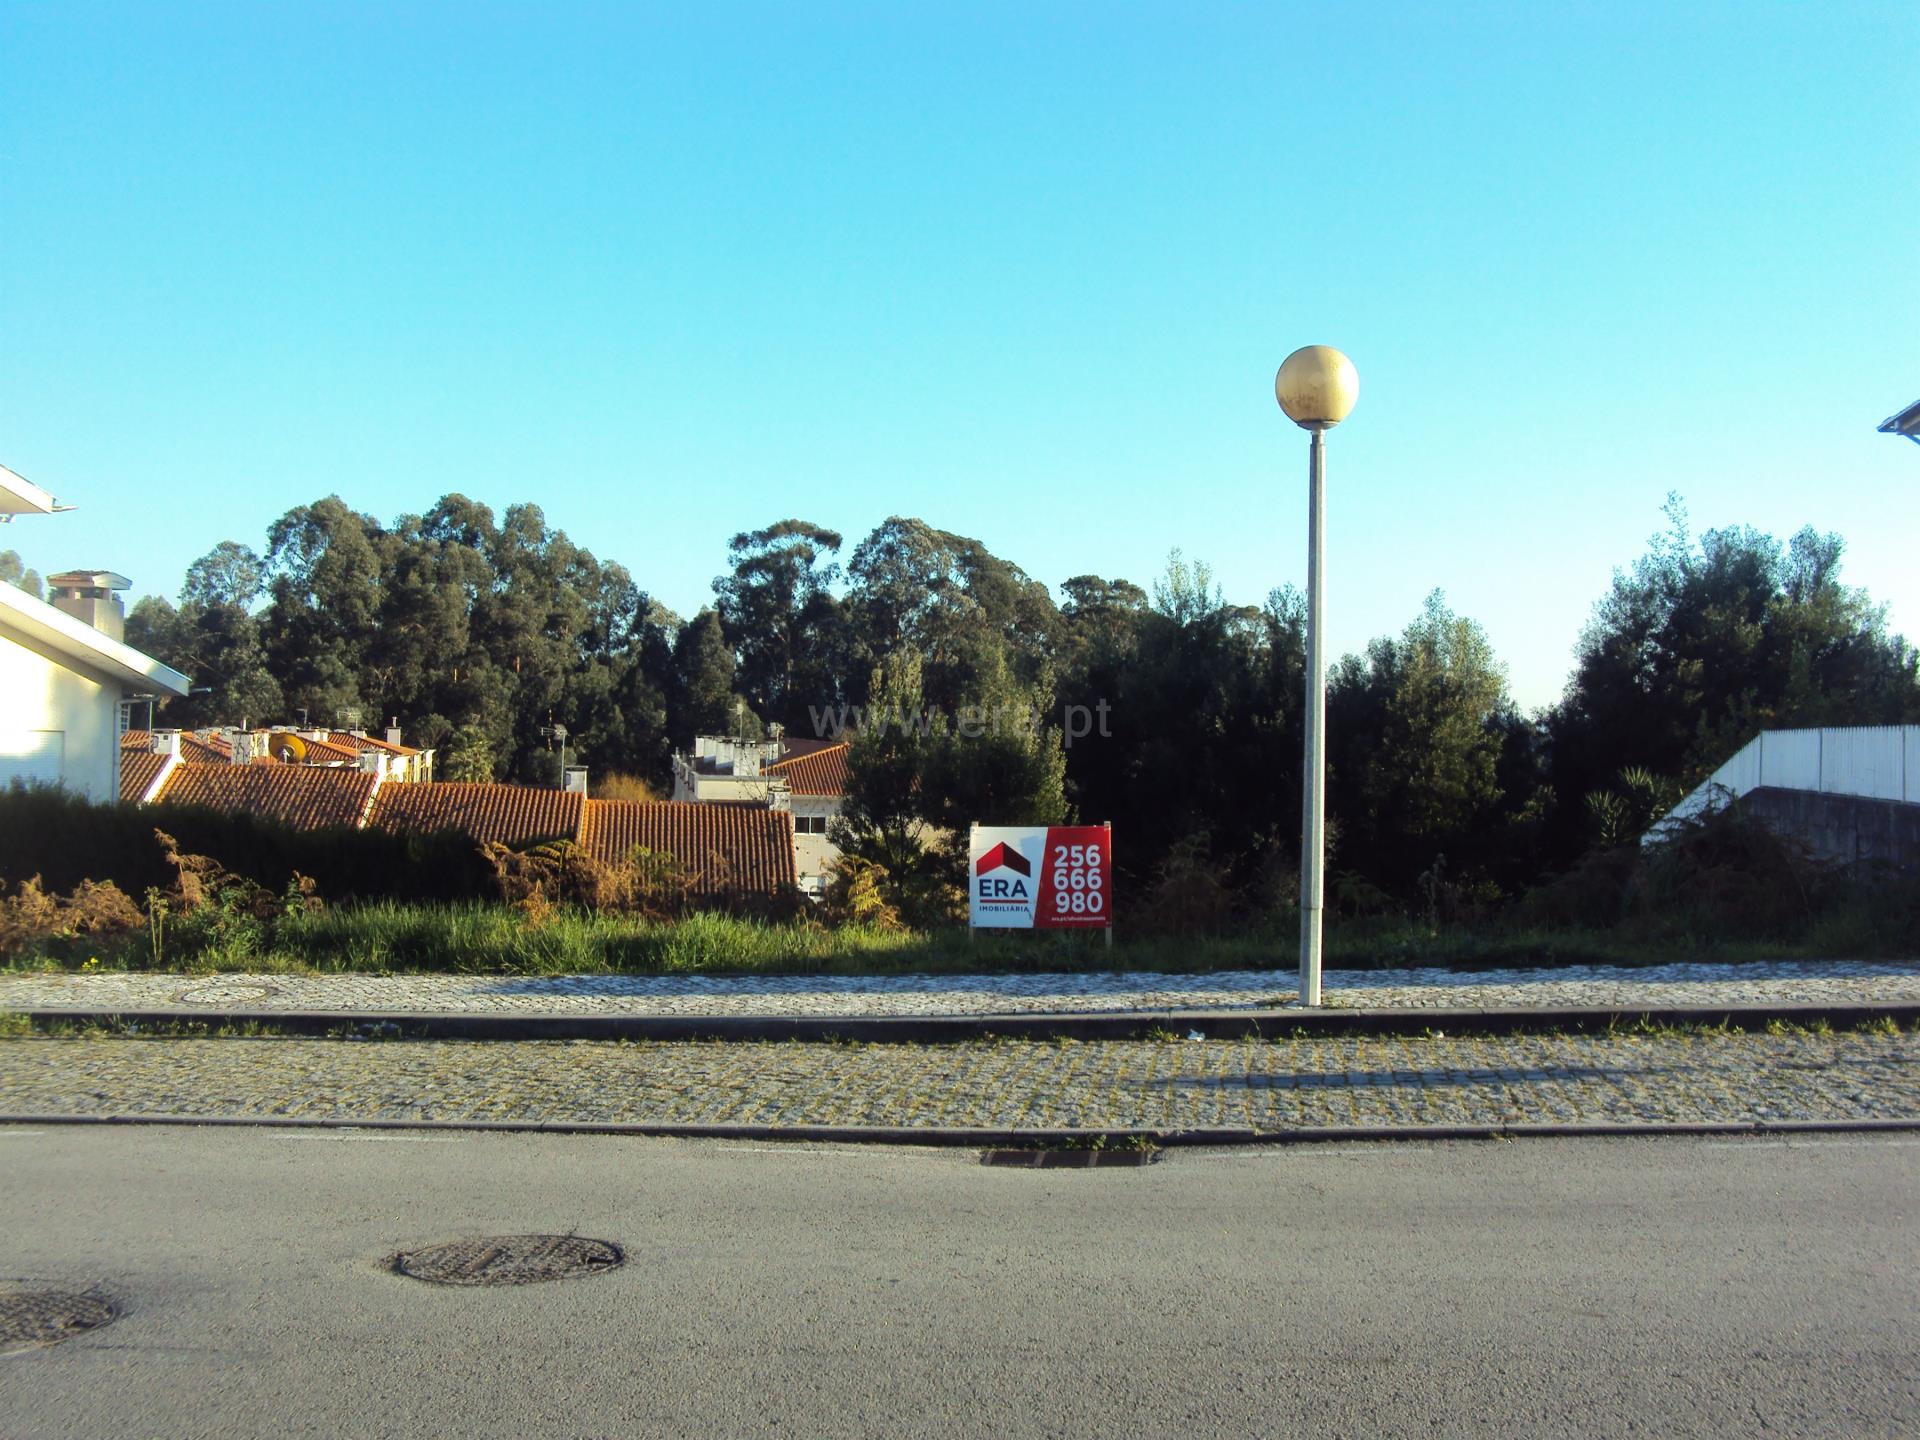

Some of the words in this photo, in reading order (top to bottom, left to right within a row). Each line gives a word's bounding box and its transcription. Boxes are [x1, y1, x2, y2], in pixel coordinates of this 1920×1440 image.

[1054, 845, 1101, 868] 256
[979, 879, 1028, 897] ERA
[1053, 868, 1102, 891] 666
[1055, 891, 1103, 913] 980
